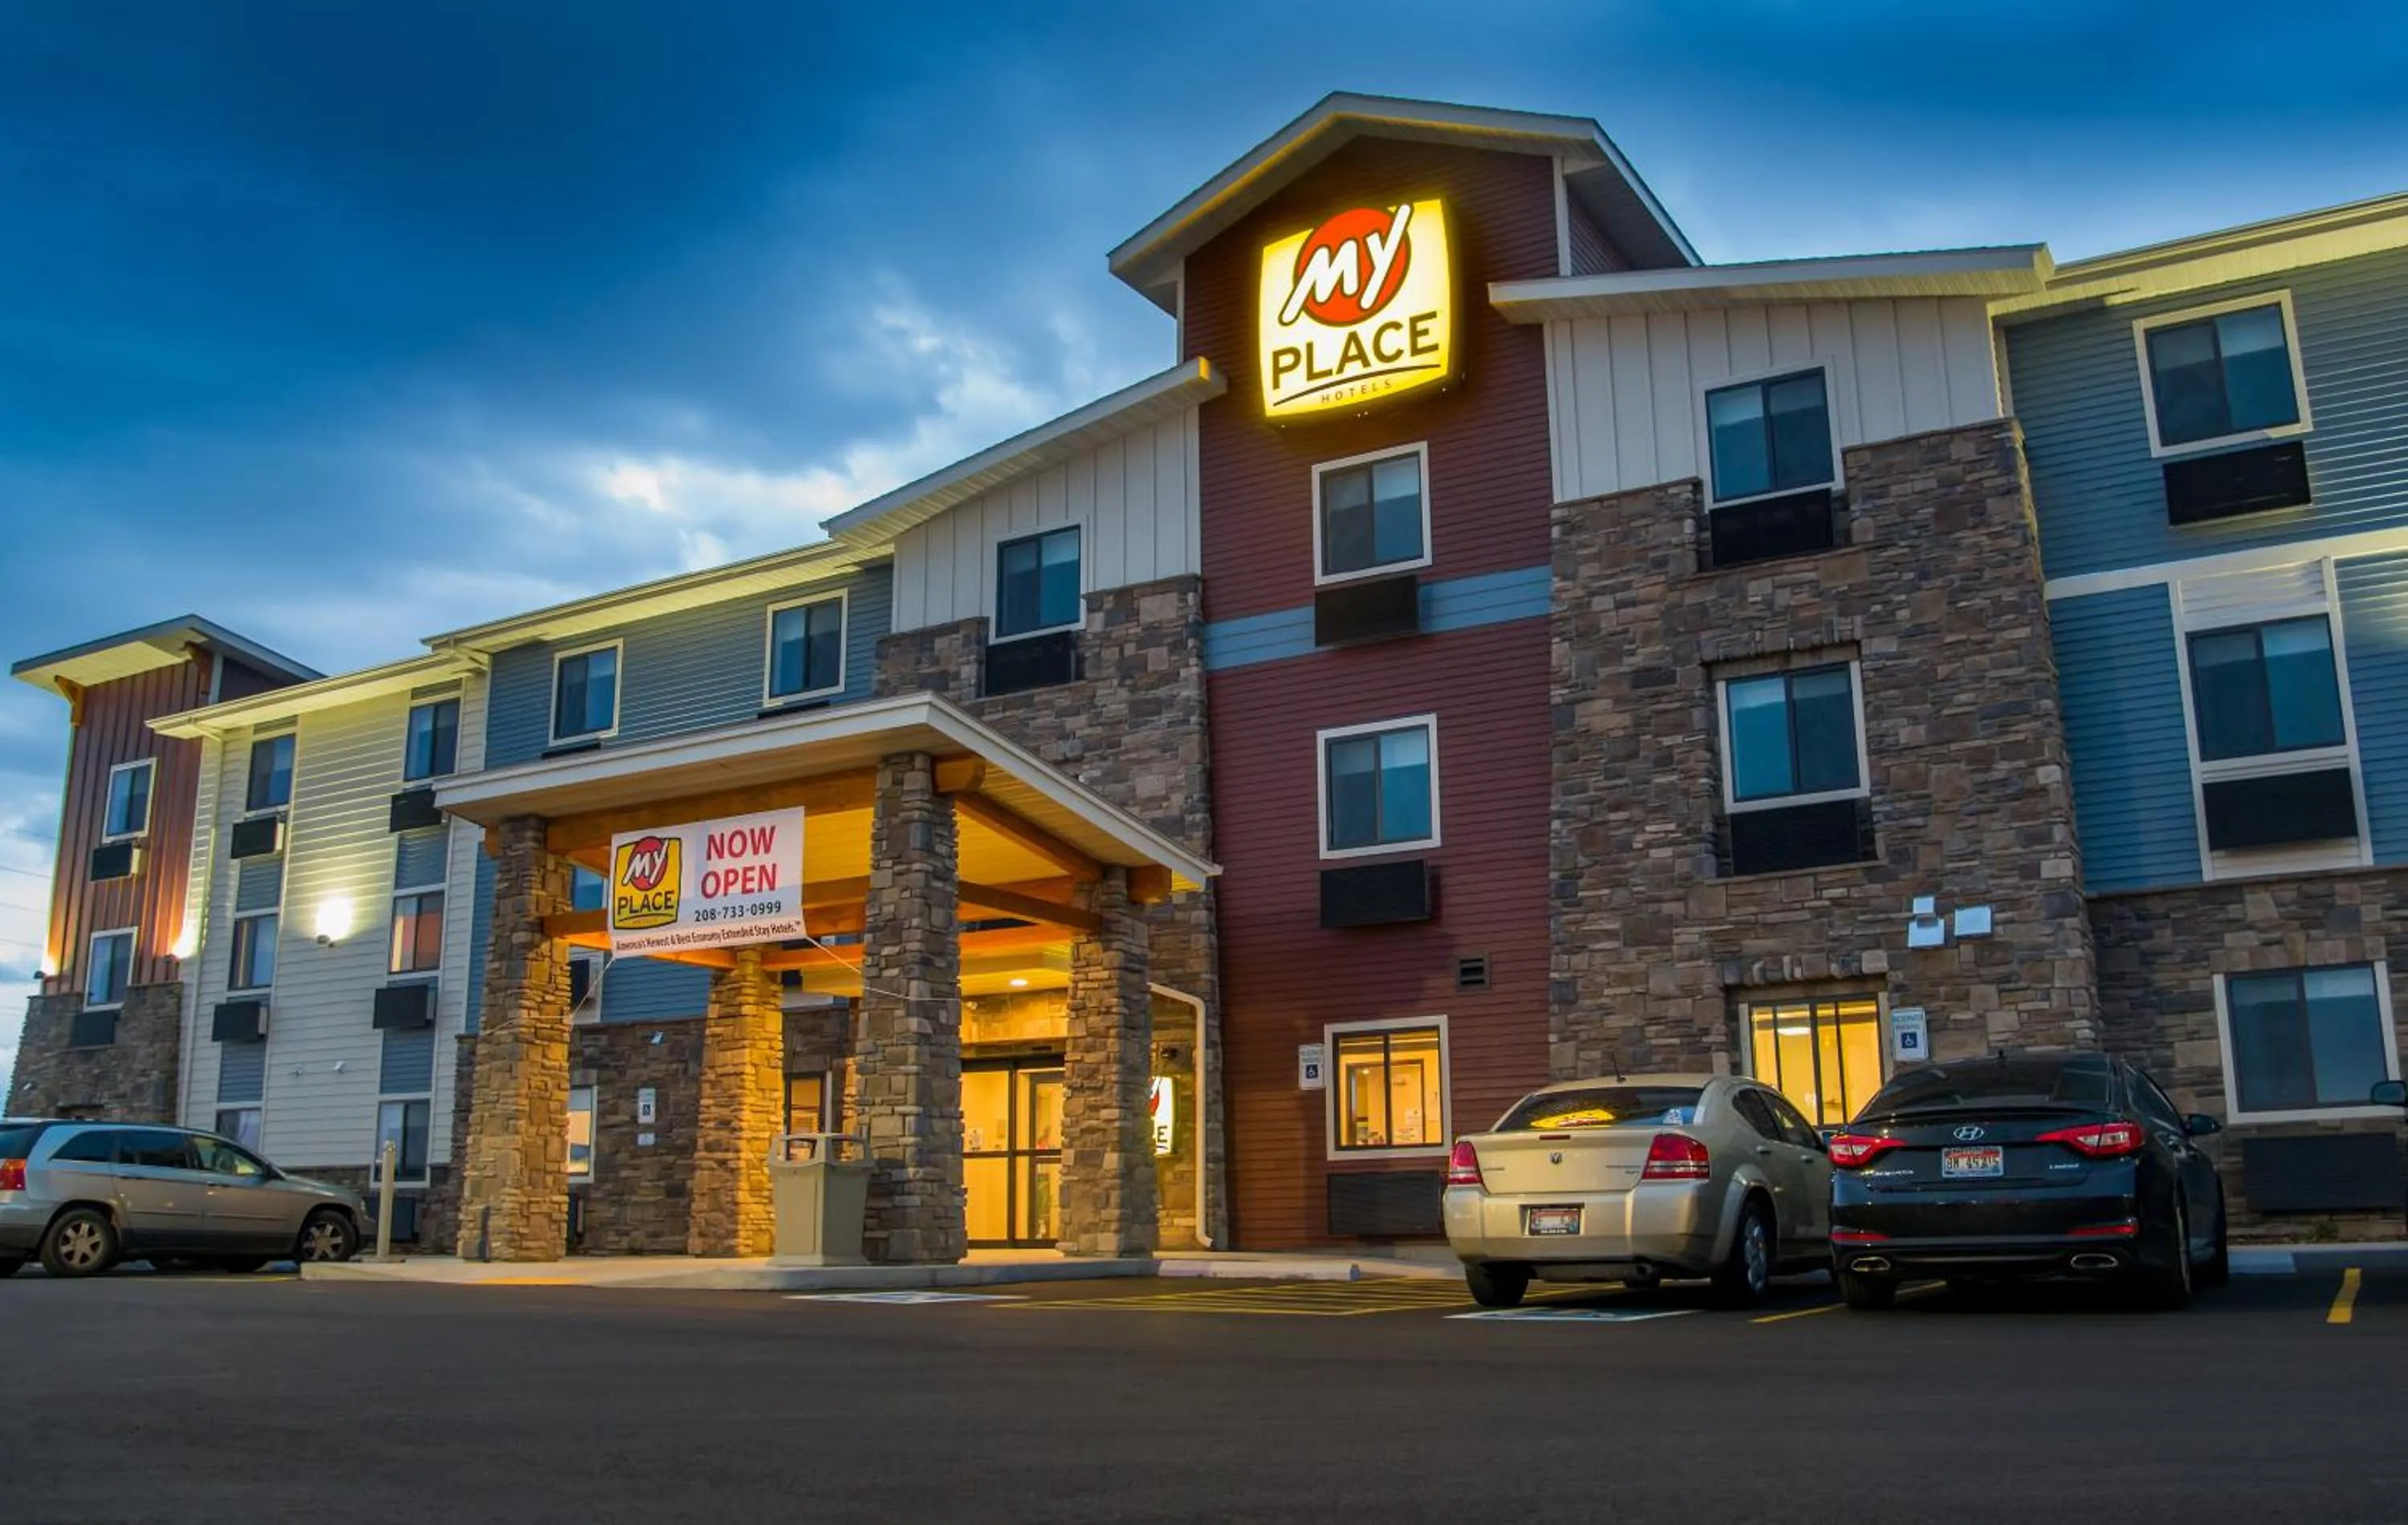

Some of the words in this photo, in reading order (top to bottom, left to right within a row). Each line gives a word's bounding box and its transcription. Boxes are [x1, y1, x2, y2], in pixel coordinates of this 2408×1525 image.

[1272, 311, 1439, 390] PLACE
[1321, 380, 1393, 403] HOTELS
[706, 825, 776, 861] NOW
[701, 864, 777, 900] OPEN
[617, 891, 675, 916] PLACE
[694, 901, 782, 922] 208-733-0999
